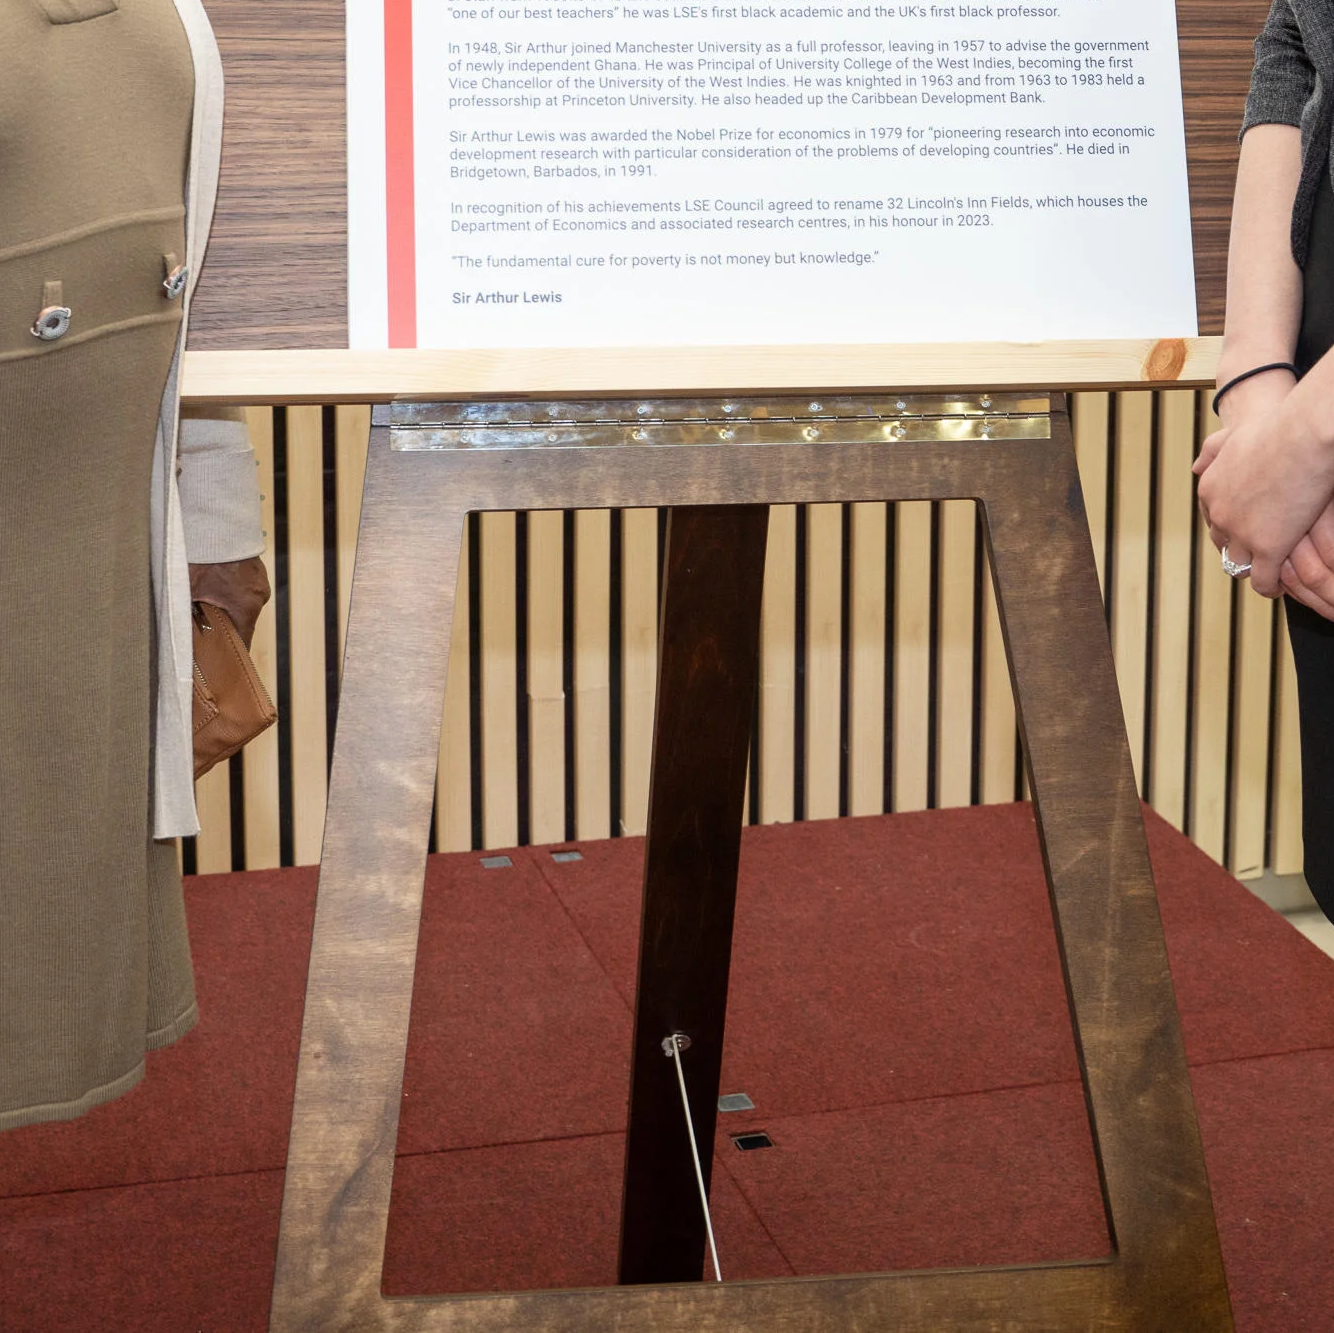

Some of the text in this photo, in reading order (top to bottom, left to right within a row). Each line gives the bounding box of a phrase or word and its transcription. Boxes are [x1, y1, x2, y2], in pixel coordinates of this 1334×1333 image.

[448, 56, 1133, 74] of newly independent Ghana. He was Principal of University College of the West Indies, becoming the first
[449, 130, 466, 142] Sir
[471, 130, 512, 142] Arthur
[517, 130, 555, 141] Lewis
[559, 132, 586, 141] was
[591, 129, 647, 141] awarded
[651, 129, 672, 140] the
[676, 128, 715, 140] Nobel
[719, 128, 752, 140] Prize
[756, 127, 774, 139] for
[778, 128, 850, 139] economics
[855, 128, 865, 138] in
[870, 127, 902, 138] 1979
[906, 126, 924, 138] for
[1005, 125, 1060, 137] research
[1064, 126, 1088, 137] into
[1092, 125, 1155, 137] economic
[450, 164, 656, 180] Bridgetown, Barbados, in 1991.
[451, 202, 462, 213] In
[467, 202, 542, 216] recognition
[547, 200, 560, 212] of
[564, 201, 583, 212] his
[588, 200, 680, 212] achievements
[685, 199, 710, 211] LSE
[714, 198, 763, 211] Council
[768, 198, 812, 213] agreed
[816, 199, 829, 210] to
[834, 200, 883, 210] rename
[887, 197, 903, 209] 32
[967, 196, 987, 208] Inn
[991, 195, 1032, 209] Fields,
[1035, 195, 1073, 207] which
[1077, 195, 1123, 208] houses
[1127, 194, 1147, 206] the
[451, 214, 993, 234] Department of Economics and associated research centres, in his honour in 2023.
[486, 254, 571, 267] fundamental
[575, 257, 605, 266] cure
[609, 253, 627, 266] for
[631, 254, 681, 268] poverty
[685, 253, 696, 265] is
[700, 254, 721, 265] not
[726, 254, 770, 267] money
[774, 252, 796, 264] but
[452, 290, 562, 303] Sir Arthur Lewis
